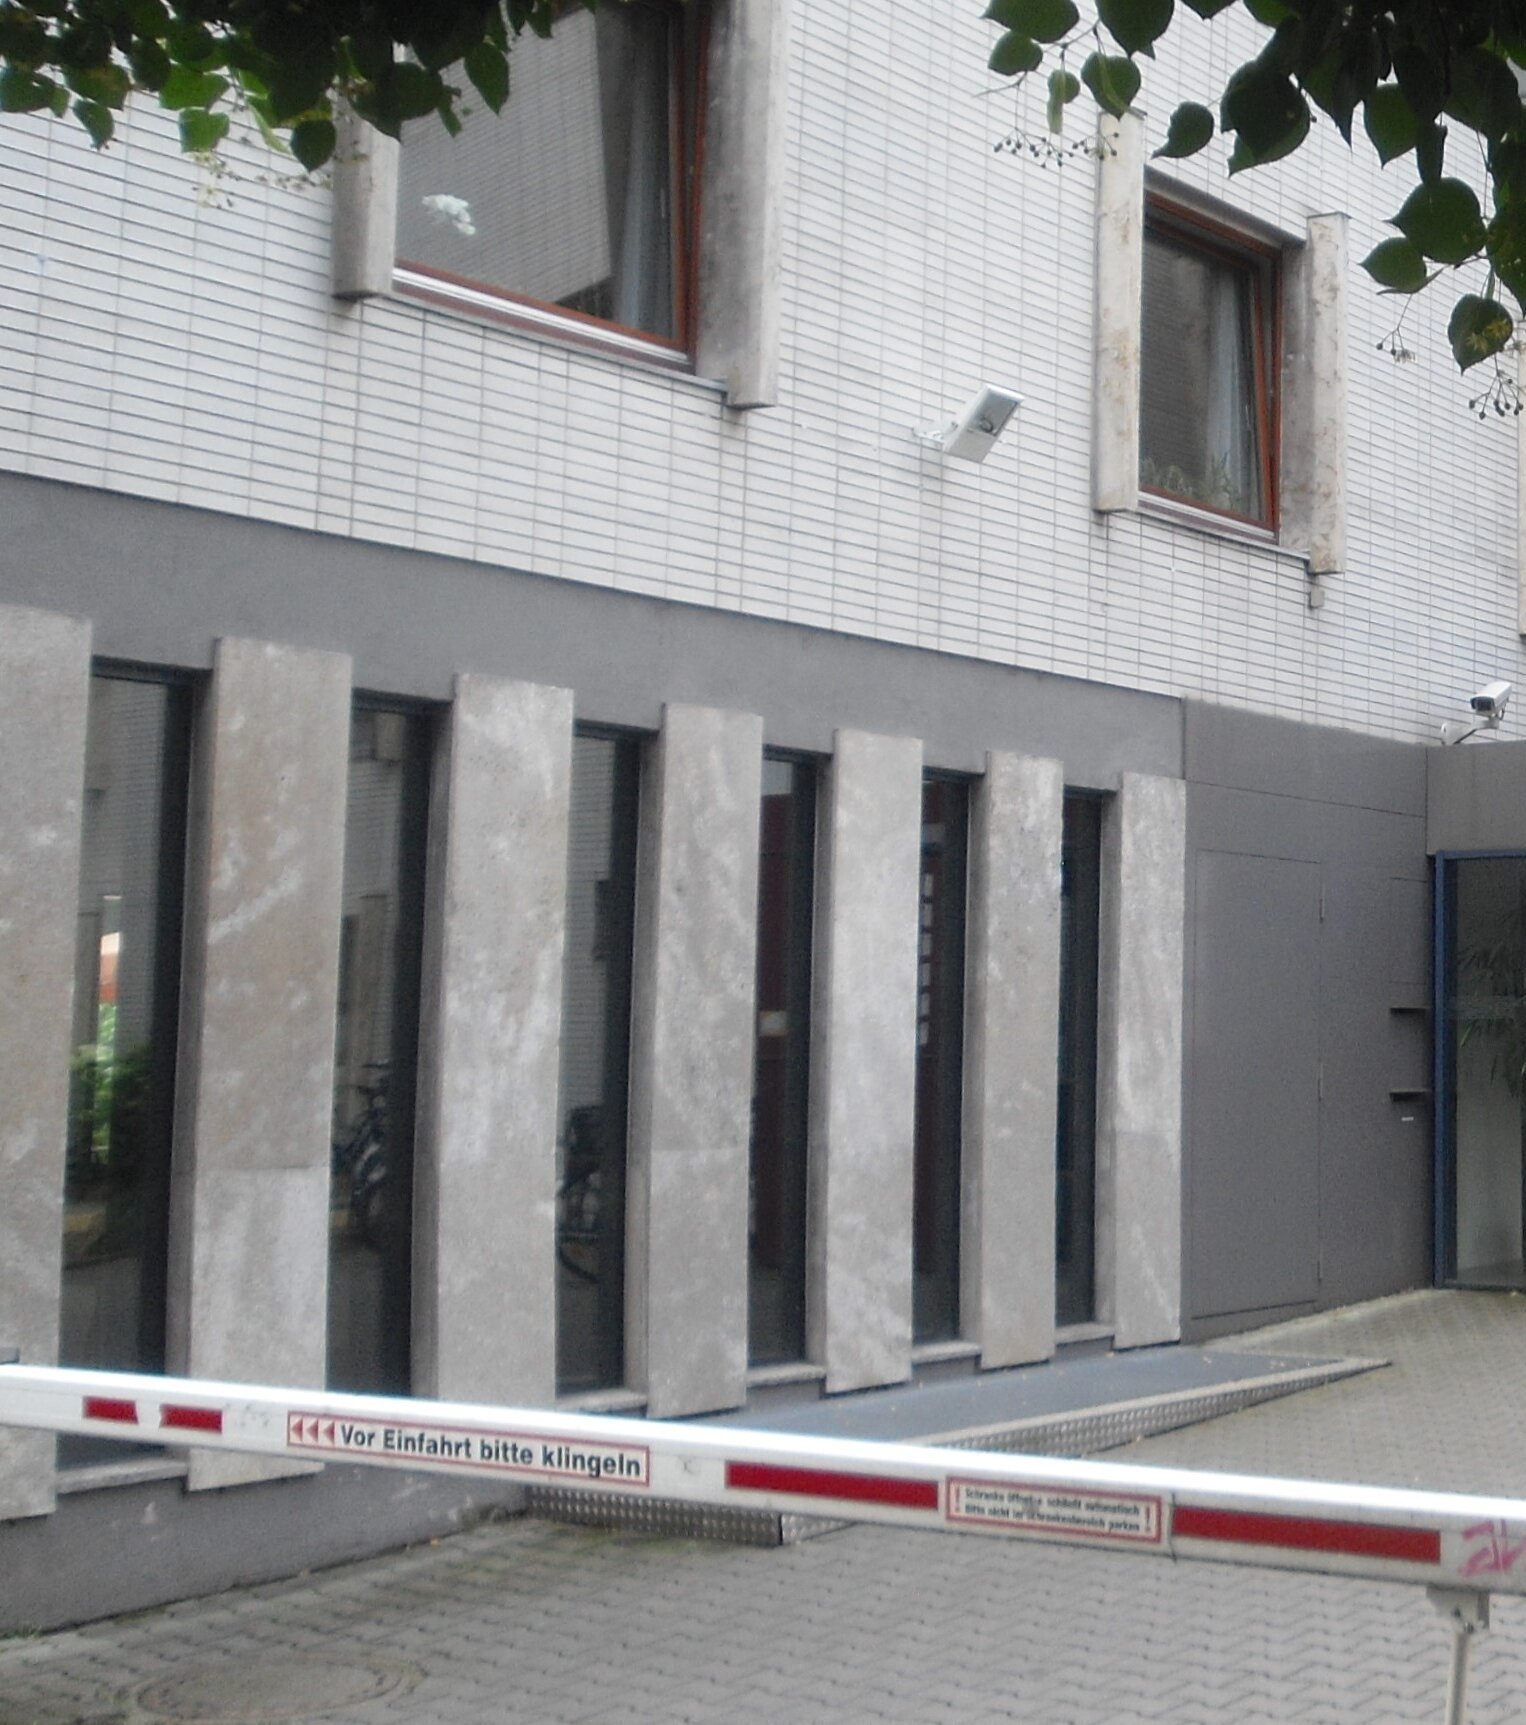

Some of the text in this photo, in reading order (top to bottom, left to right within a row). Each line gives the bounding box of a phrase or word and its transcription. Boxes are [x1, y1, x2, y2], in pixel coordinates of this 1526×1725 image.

[340, 1423, 641, 1478] Vor Einfahrt bitte klingeln
[965, 1487, 1004, 1500] Schranke
[1085, 1503, 1139, 1515] automatisch
[965, 1504, 985, 1513] Bitte
[988, 1507, 1009, 1518] nicht
[1108, 1521, 1140, 1533] parken
